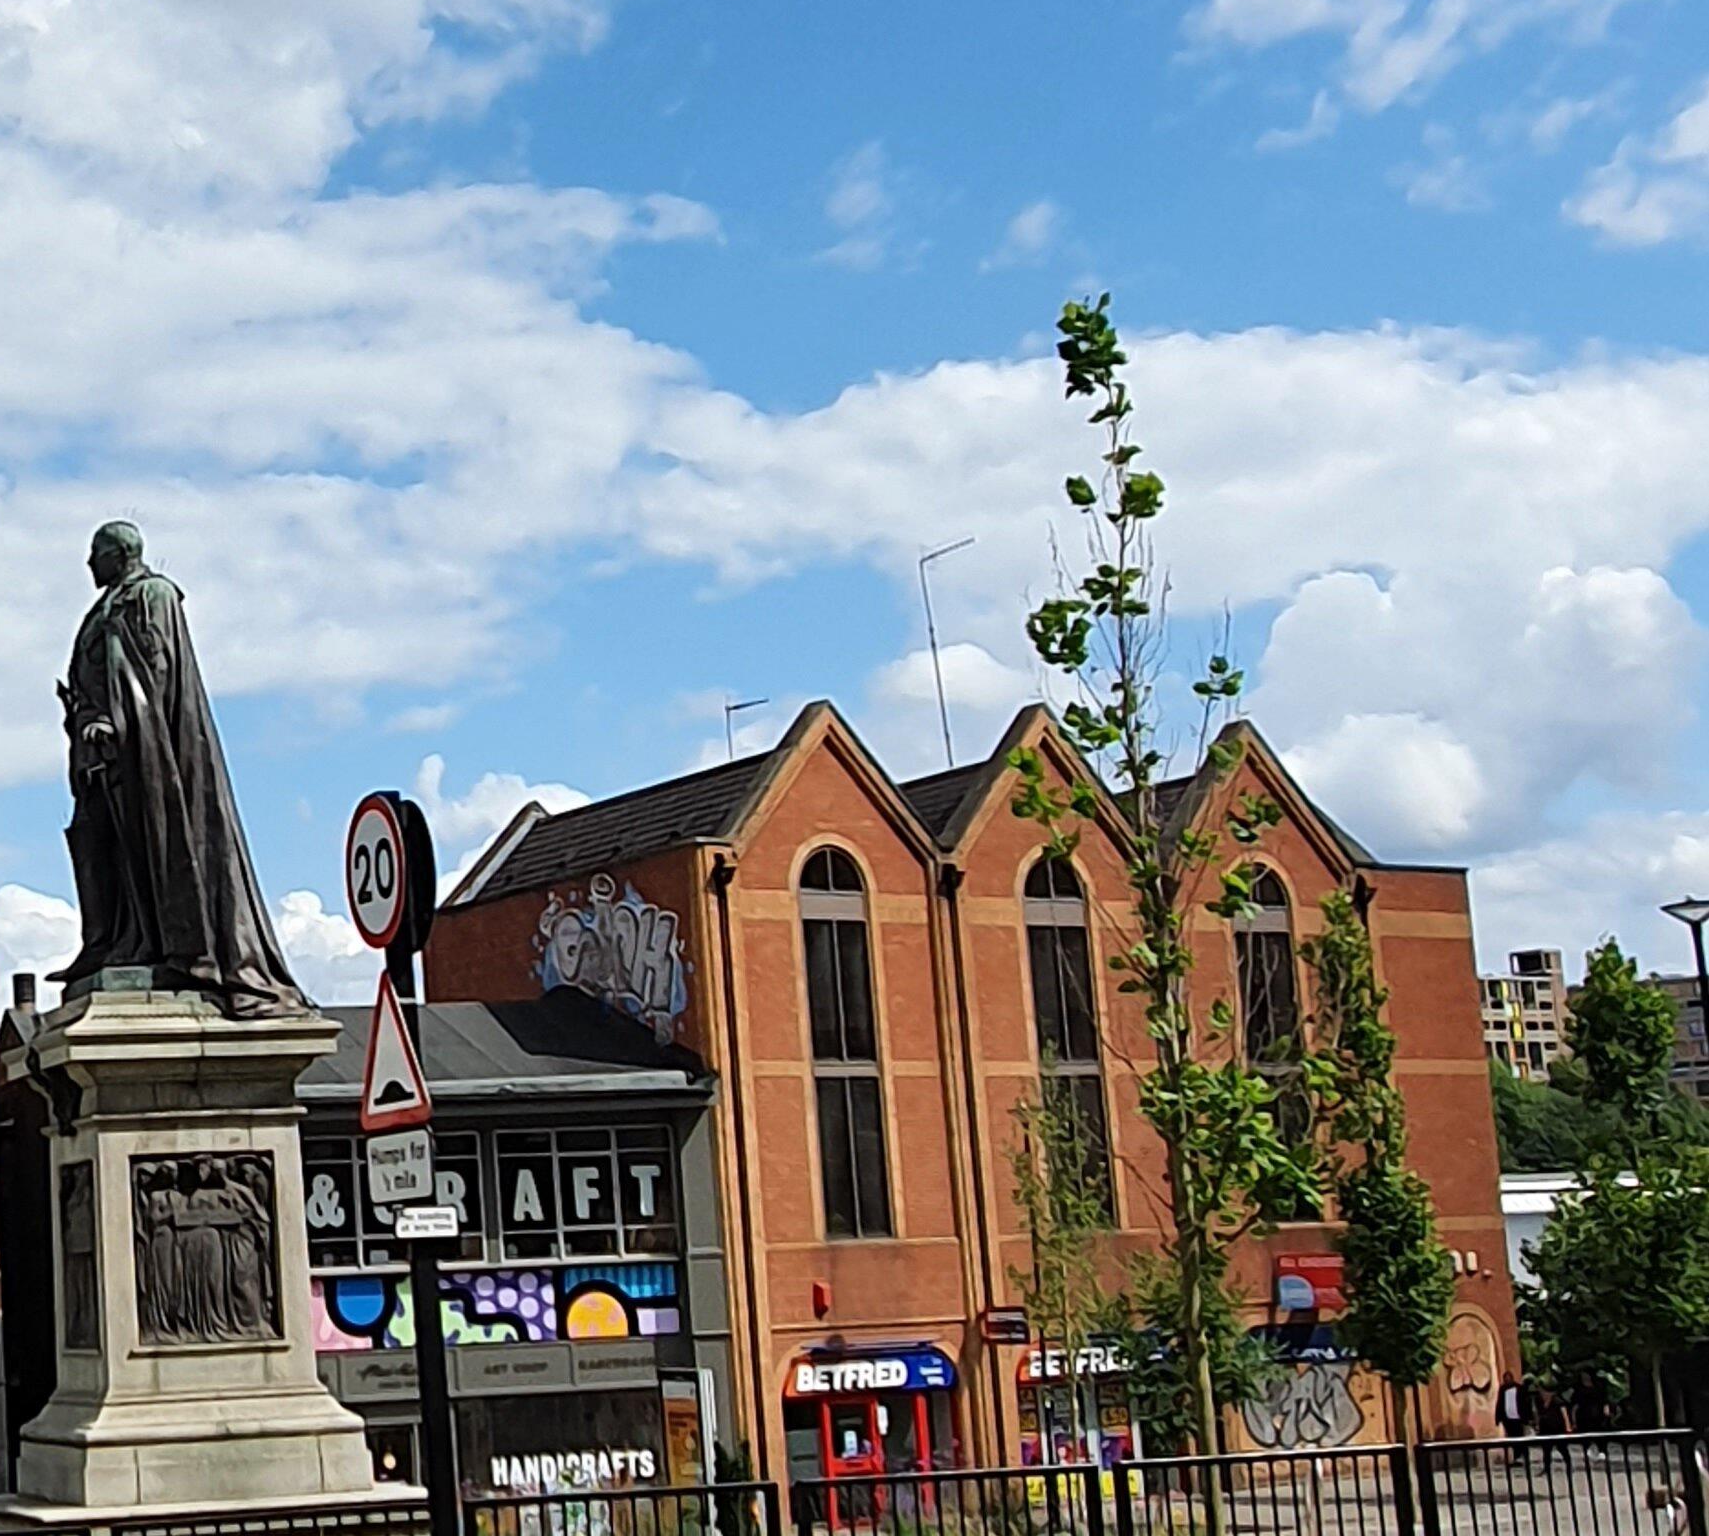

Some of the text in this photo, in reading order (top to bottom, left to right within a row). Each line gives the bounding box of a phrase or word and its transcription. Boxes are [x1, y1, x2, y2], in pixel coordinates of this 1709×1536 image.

[354, 837, 394, 905] 20
[307, 1165, 661, 1228] & RAFT
[796, 1358, 908, 1392] BETFRED
[491, 1450, 655, 1486] HANDICRAFTS
